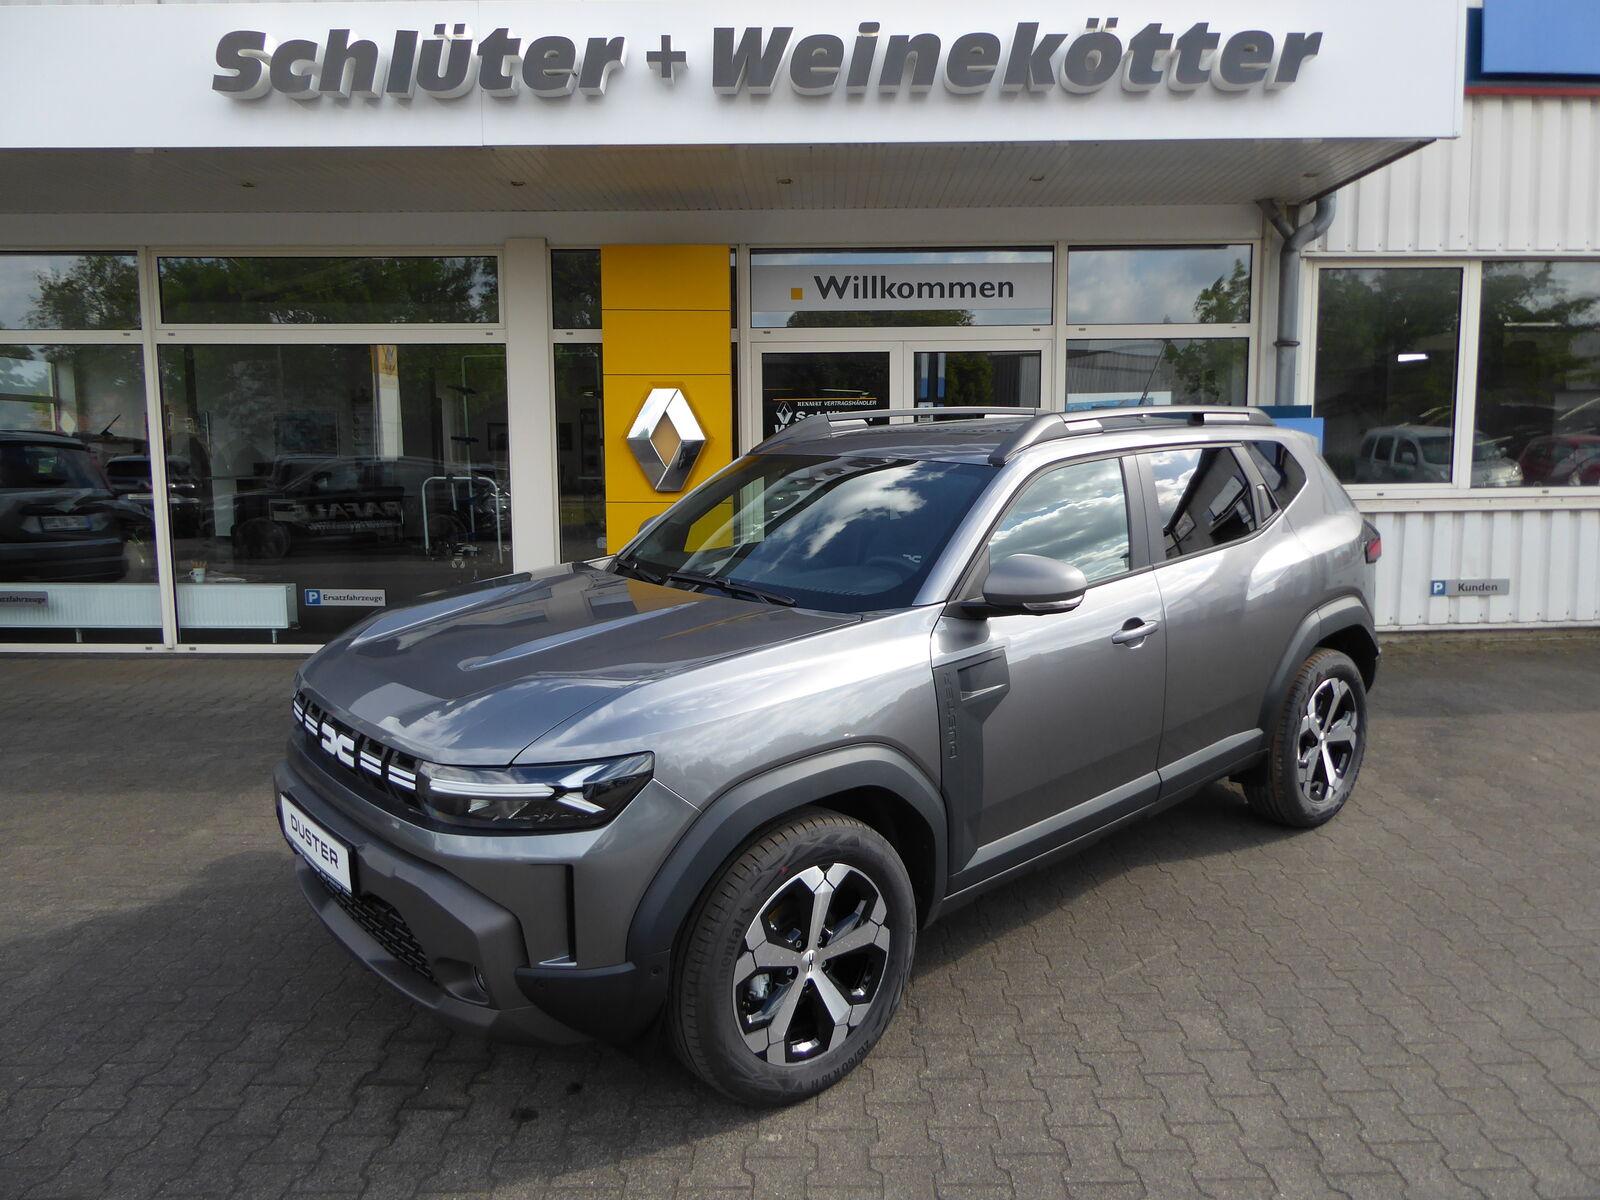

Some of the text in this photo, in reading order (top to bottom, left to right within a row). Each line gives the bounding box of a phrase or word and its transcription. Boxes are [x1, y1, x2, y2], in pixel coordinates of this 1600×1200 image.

[212, 18, 1323, 96] Schlüter + Weinekötter
[813, 275, 1014, 300] Willkommen
[308, 591, 383, 603] P Ersatzfahrzeuge
[1433, 582, 1498, 594] P Kunden
[944, 672, 957, 759] DUSTER
[290, 813, 339, 870] DUSTER
